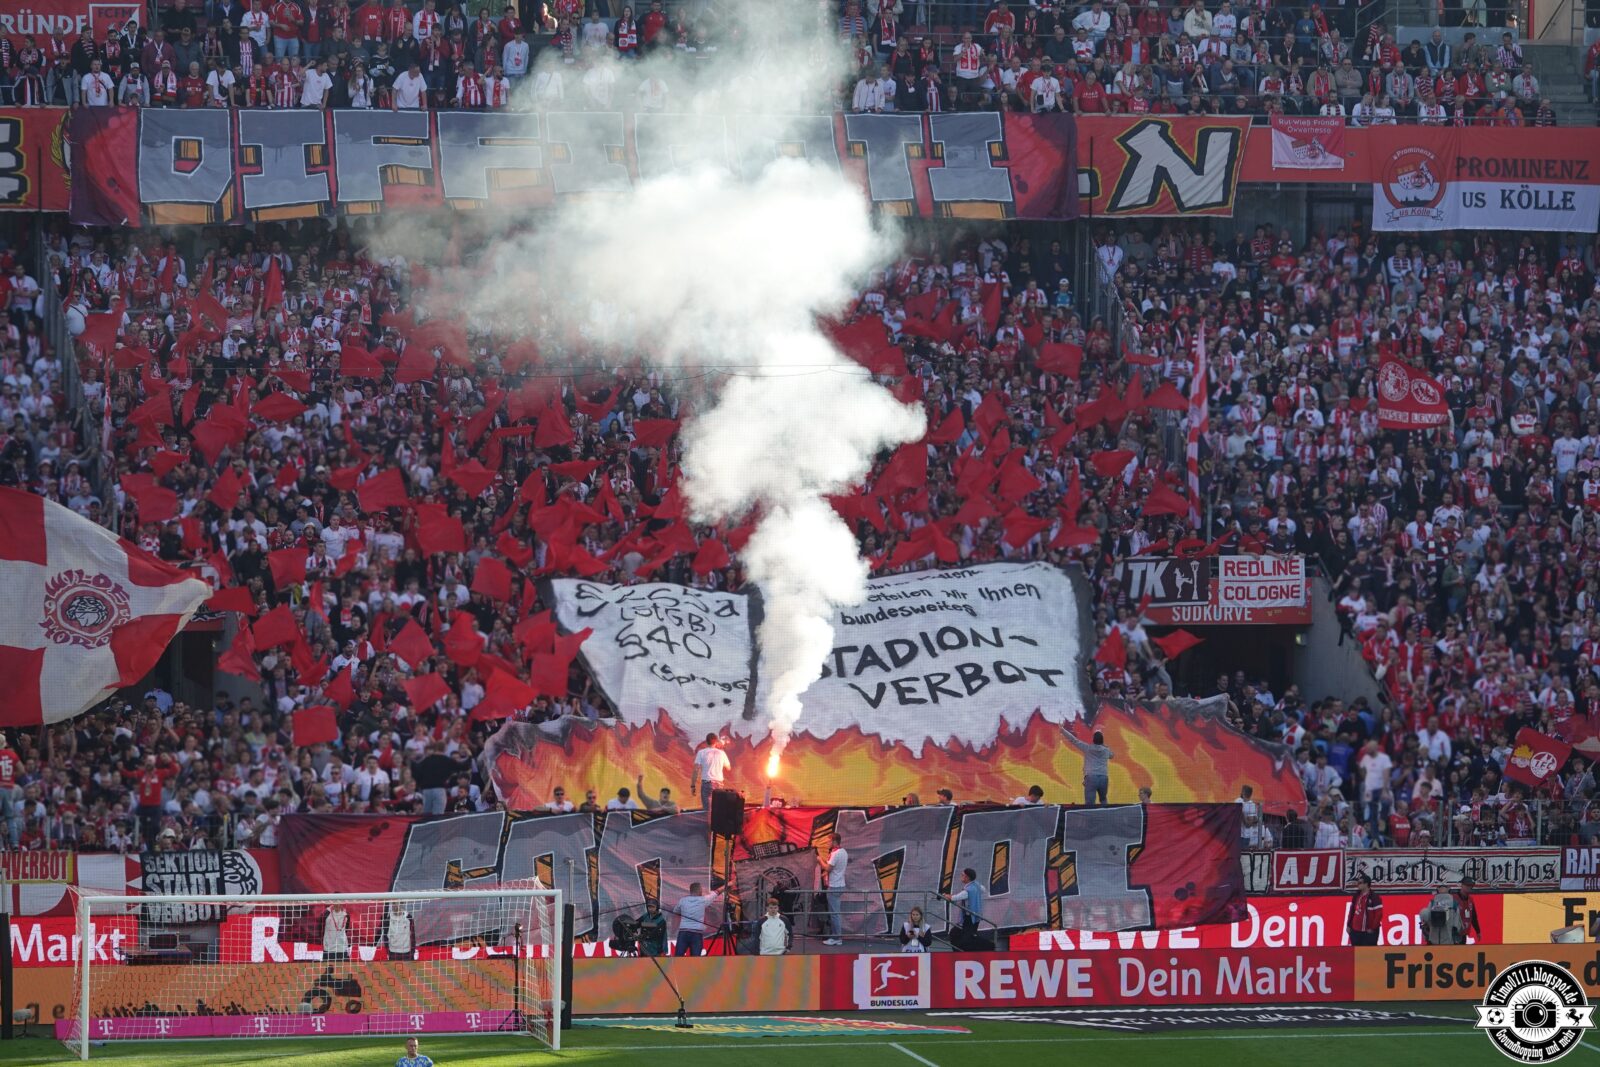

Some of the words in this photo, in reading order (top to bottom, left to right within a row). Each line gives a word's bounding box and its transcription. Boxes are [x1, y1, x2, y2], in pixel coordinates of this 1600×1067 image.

[1456, 156, 1589, 179] PROMINENZ
[1462, 191, 1487, 208] US
[1500, 184, 1576, 211] KÖLLE
[1224, 560, 1300, 576] REDLINE
[978, 582, 1041, 601] Ihnen
[1224, 584, 1300, 601] COLOGNE
[840, 601, 978, 626] bundesweites
[848, 660, 1064, 709] VERBOT
[145, 851, 220, 873] SEKTION
[1279, 856, 1337, 885] AJJ
[1461, 857, 1557, 886] Mythos
[1230, 903, 1326, 947] Dein
[10, 923, 126, 962] Markt
[954, 958, 1093, 1000] REWE
[1118, 957, 1201, 997] Dein
[1216, 955, 1332, 995] Markt
[1384, 952, 1496, 988] Frisch
[870, 999, 919, 1007] BUNDESLIGA
